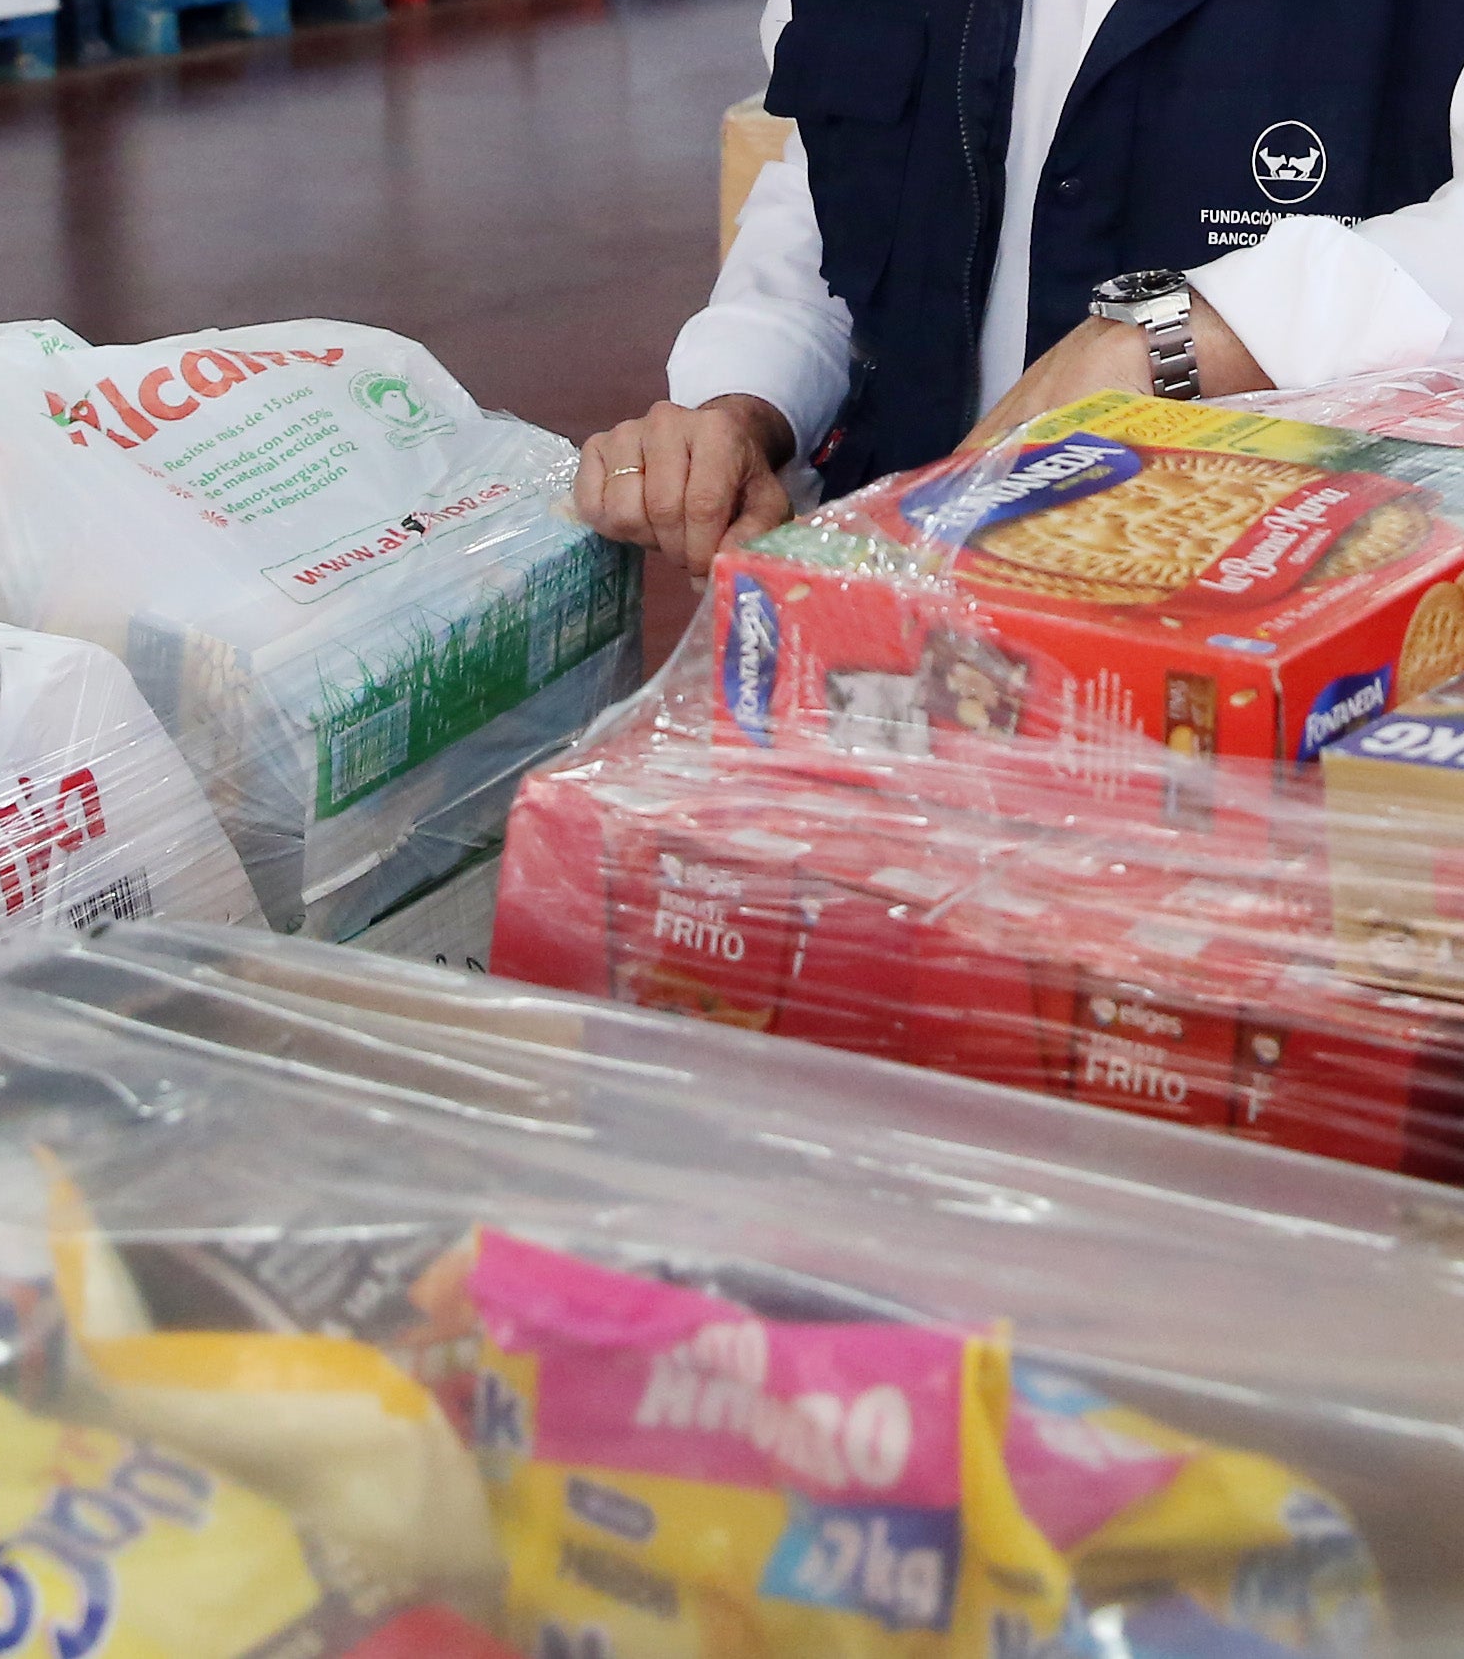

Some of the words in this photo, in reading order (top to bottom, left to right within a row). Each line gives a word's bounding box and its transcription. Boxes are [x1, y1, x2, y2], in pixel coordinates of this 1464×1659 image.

[1200, 209, 1282, 226] FUNDACIÓN
[1208, 231, 1258, 246] BANCO
[164, 438, 217, 472] Resiste
[217, 423, 245, 442] más
[245, 410, 265, 428] de
[263, 397, 282, 414] 15
[284, 386, 314, 405] usos
[256, 435, 283, 456] con
[283, 422, 303, 438] un
[301, 408, 333, 428] 15%
[223, 456, 280, 491] material
[279, 423, 340, 462] reciclado
[271, 463, 349, 510] fabricación
[1304, 675, 1387, 752] FONTANEDA
[653, 909, 745, 962] FRITO
[1086, 1057, 1187, 1104] FRITO
